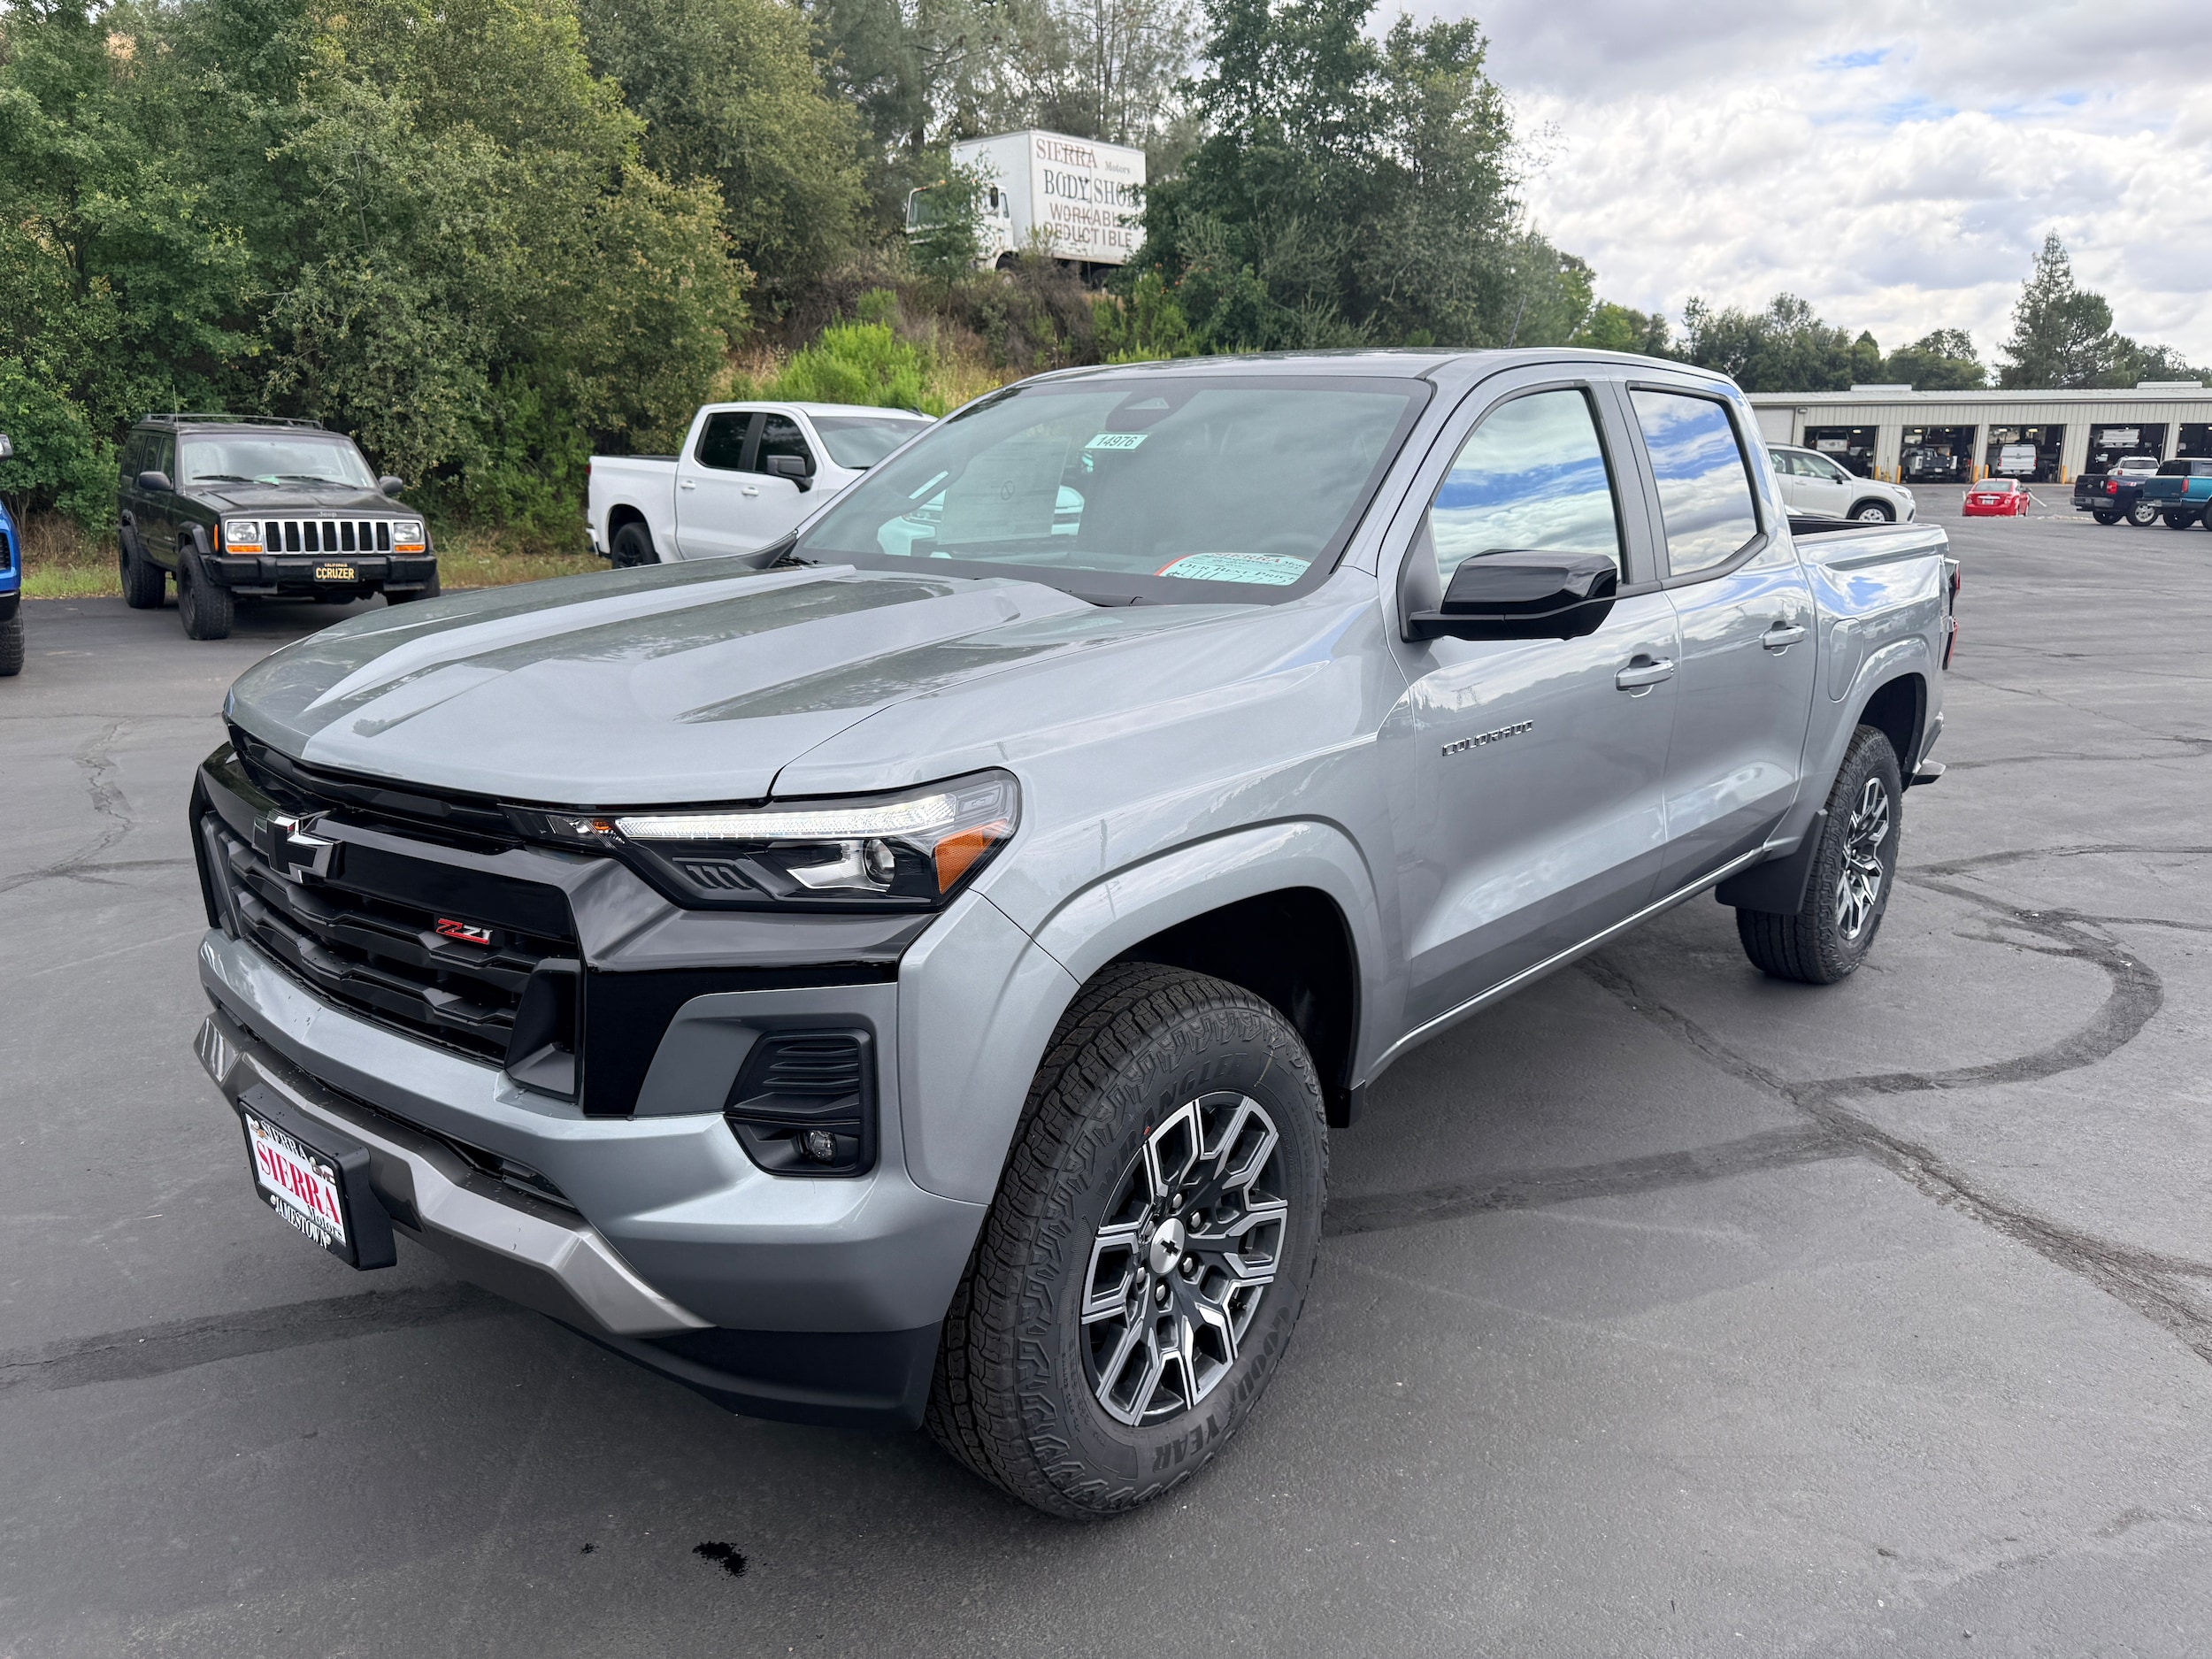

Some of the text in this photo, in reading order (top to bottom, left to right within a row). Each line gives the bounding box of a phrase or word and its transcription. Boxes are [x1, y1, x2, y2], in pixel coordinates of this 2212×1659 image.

[1036, 138, 1131, 174] SIERRA Motors
[1044, 169, 1090, 202] BODY
[1049, 203, 1130, 229] WORKABL
[1045, 222, 1133, 248] DEDUCTIBLE
[1097, 435, 1138, 447] 14976
[316, 567, 355, 580] CCRUZER
[1442, 719, 1534, 757] COLORADO
[436, 918, 494, 945] Z71
[260, 1120, 309, 1161] SIERRA
[256, 1140, 342, 1225] SIERRA
[311, 1165, 336, 1186] GMC
[274, 1196, 328, 1249] JAMESTOWN
[307, 1204, 343, 1240] Motors
